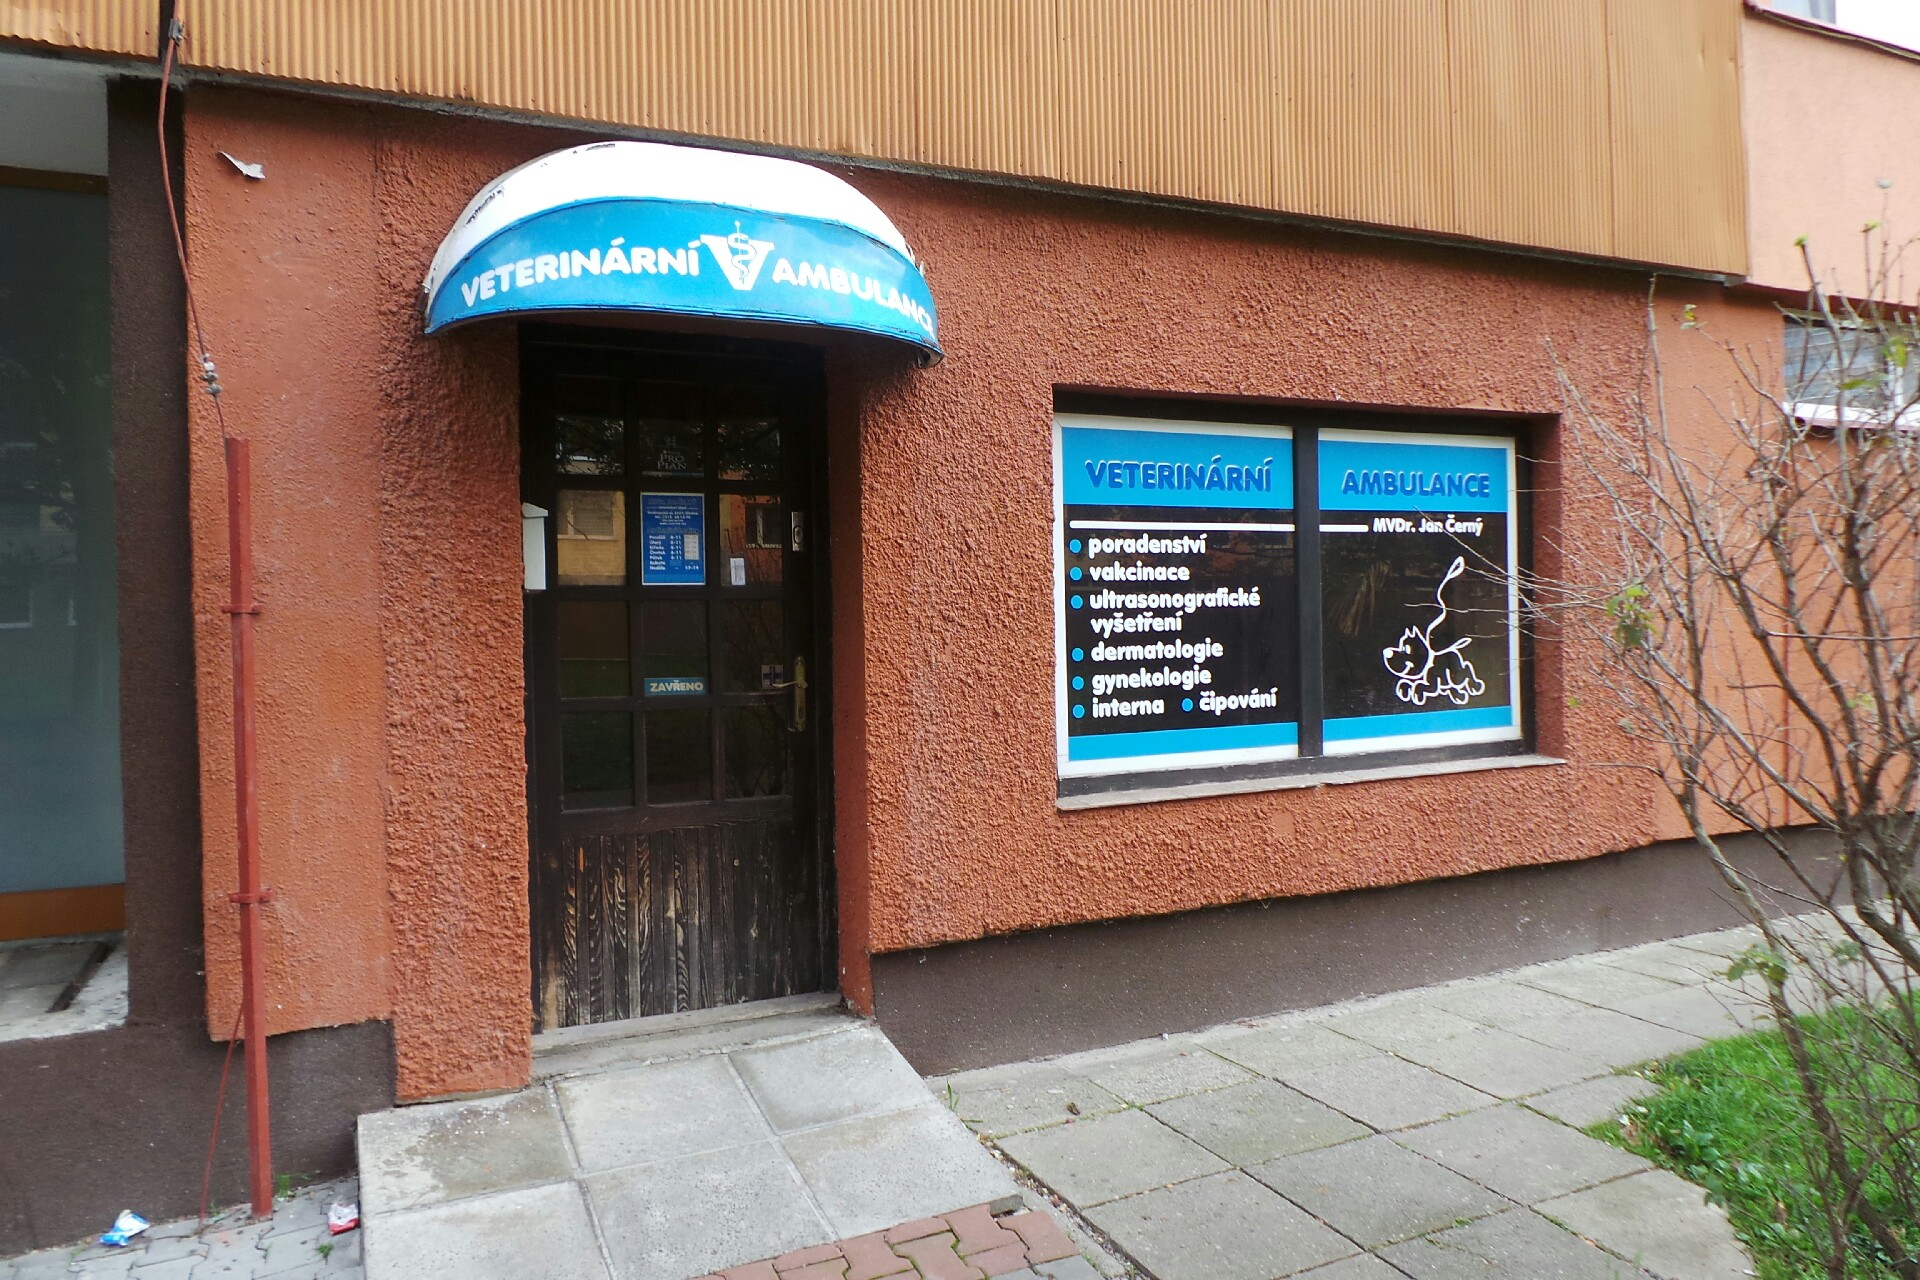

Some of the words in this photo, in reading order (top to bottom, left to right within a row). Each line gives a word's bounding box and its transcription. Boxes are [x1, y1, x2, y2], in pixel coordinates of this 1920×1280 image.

[461, 236, 700, 308] VETERINÁRNÍ
[1084, 454, 1274, 493] VETERINÁRNÍ
[1341, 469, 1490, 498] AMBULANCE
[1372, 517, 1416, 534] MVDr.
[1418, 517, 1444, 534] Jan
[1445, 513, 1484, 537] Černý
[1088, 532, 1208, 559] poradenství
[1089, 560, 1190, 581] vakcinace
[1089, 585, 1261, 613] ultrasonografické
[1090, 610, 1184, 638] vyšetření
[1090, 637, 1224, 663] dermatologie
[649, 679, 704, 693] ZAVŘENO
[1092, 664, 1212, 695] gynekologie
[1092, 697, 1165, 718] interna
[1199, 687, 1278, 716] čipování
